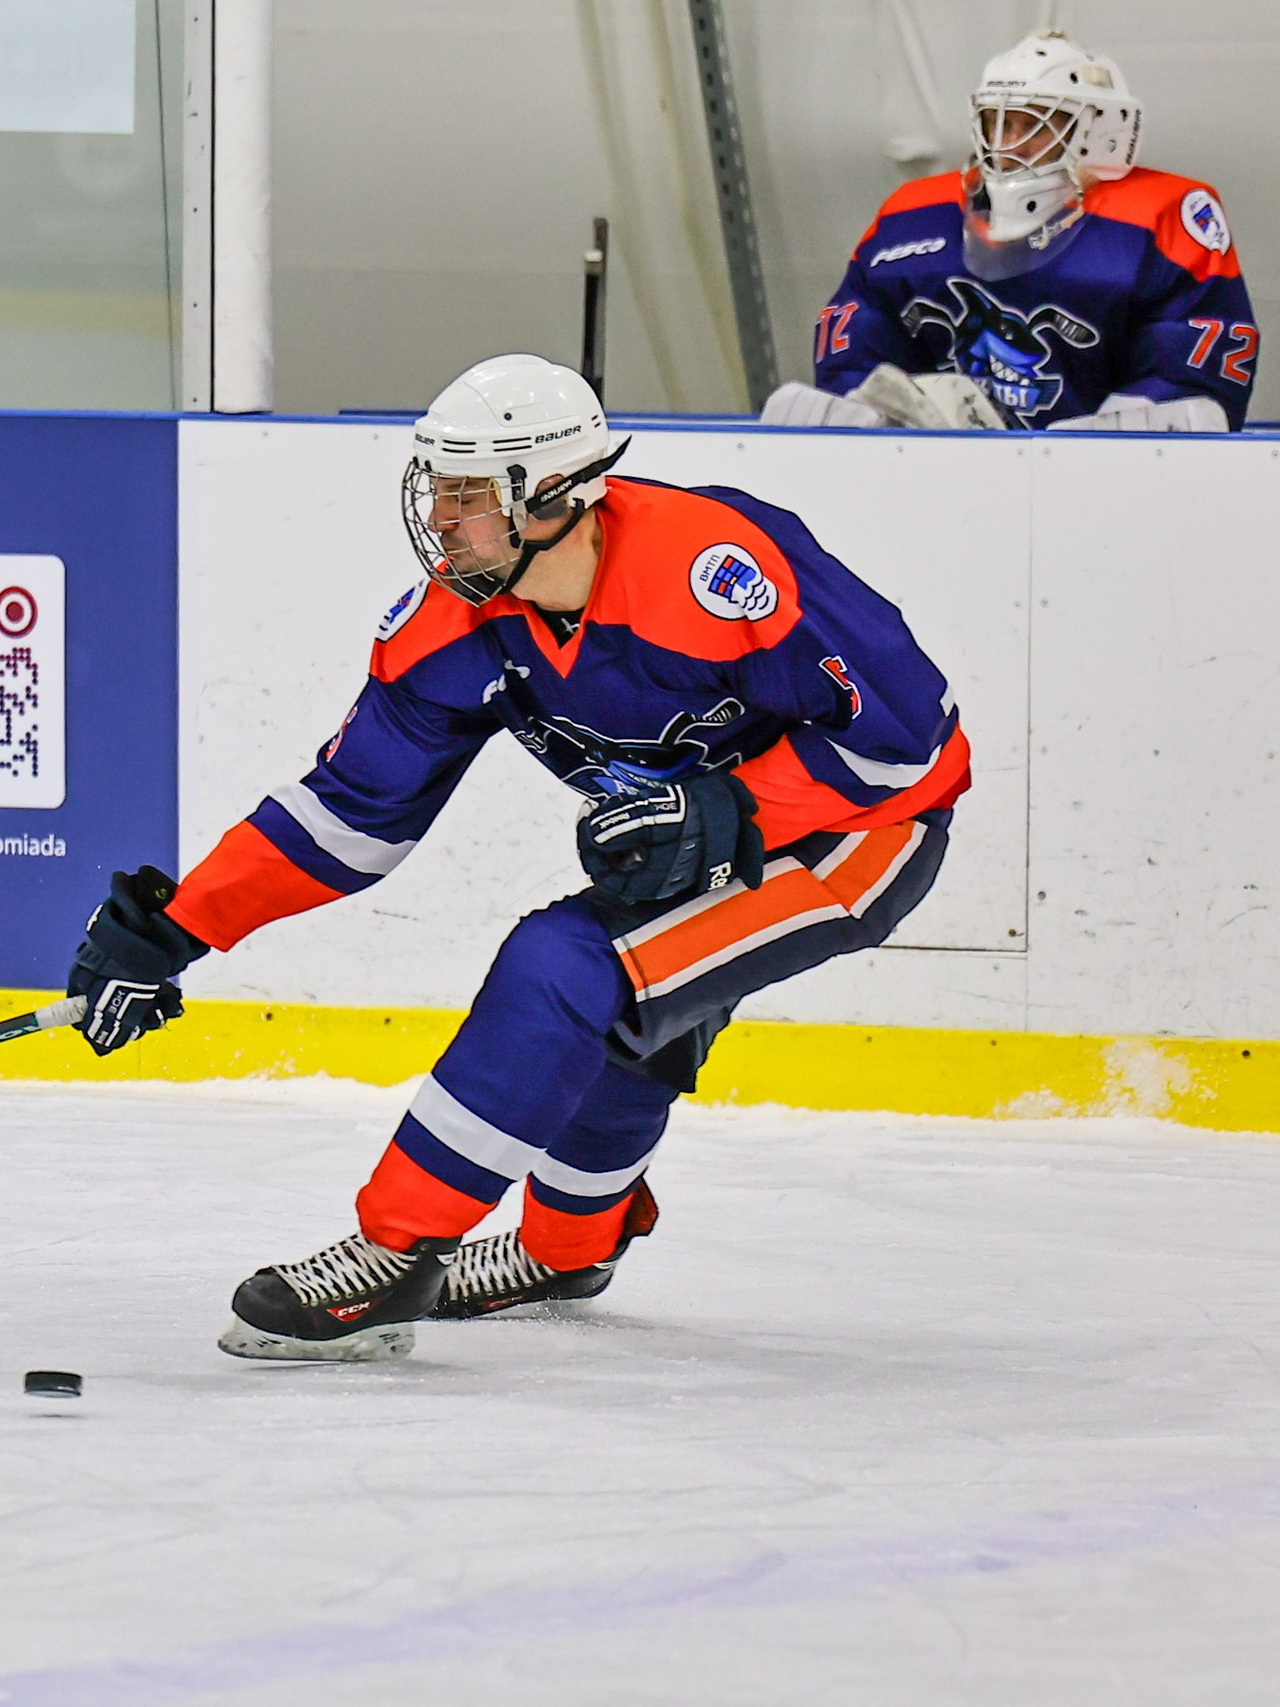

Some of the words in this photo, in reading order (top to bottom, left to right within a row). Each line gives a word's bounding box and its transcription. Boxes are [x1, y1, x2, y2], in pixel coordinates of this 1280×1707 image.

[1187, 318, 1260, 387] 72
[534, 425, 582, 444] BAUER
[699, 554, 721, 582] ВМТП
